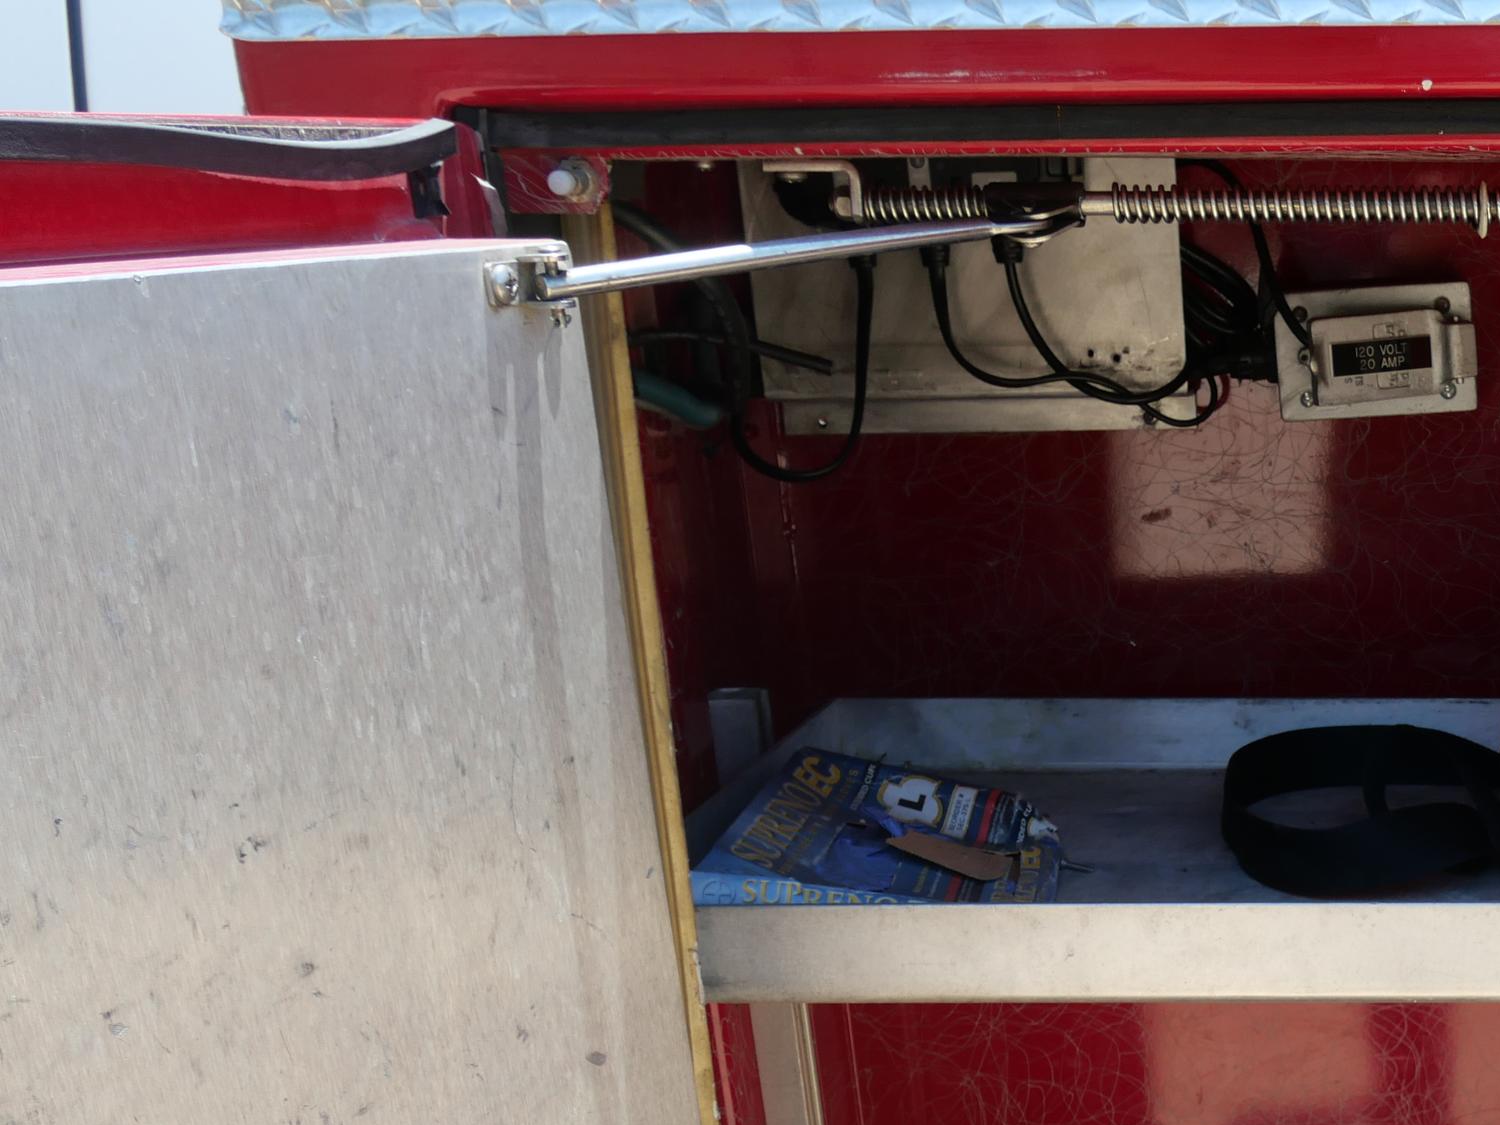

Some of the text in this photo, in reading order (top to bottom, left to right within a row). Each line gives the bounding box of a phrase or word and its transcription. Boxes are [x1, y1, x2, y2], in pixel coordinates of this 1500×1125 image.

[1354, 342, 1408, 358] 120 VOLT
[1359, 355, 1406, 371] 20 AMP
[898, 794, 927, 812] L
